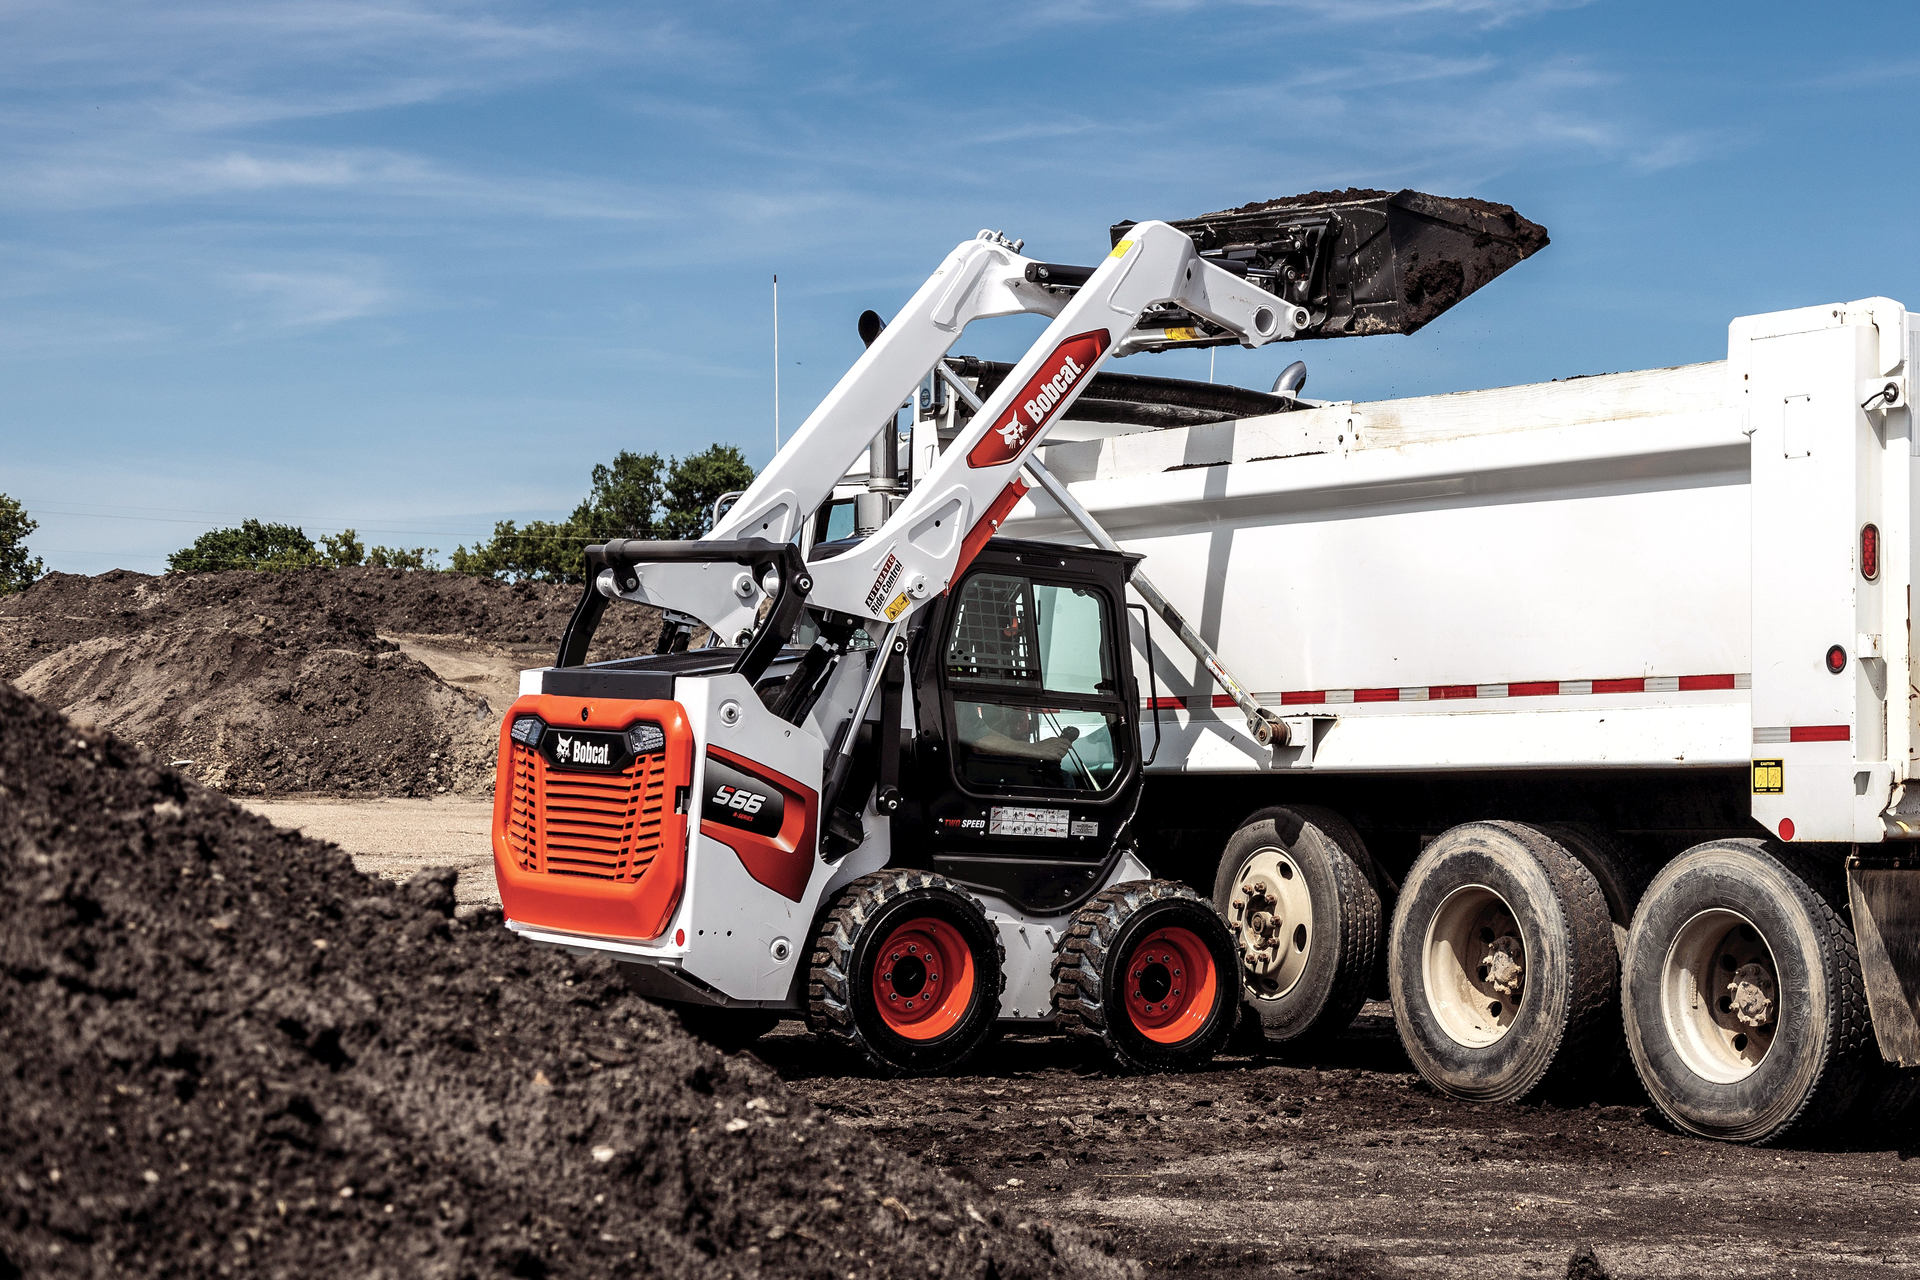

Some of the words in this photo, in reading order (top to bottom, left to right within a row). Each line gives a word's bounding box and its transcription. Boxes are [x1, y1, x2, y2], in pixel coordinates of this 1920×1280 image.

[1023, 355, 1082, 424] Bobcat
[866, 556, 895, 607] AUTOMATIC
[870, 593, 886, 616] Ride
[881, 559, 903, 595] Control
[572, 740, 609, 765] Bobcat
[712, 785, 767, 814] S66
[944, 819, 961, 827] TWO
[961, 819, 986, 829] SPEED
[1776, 921, 1802, 1043] YOKOHAMA
